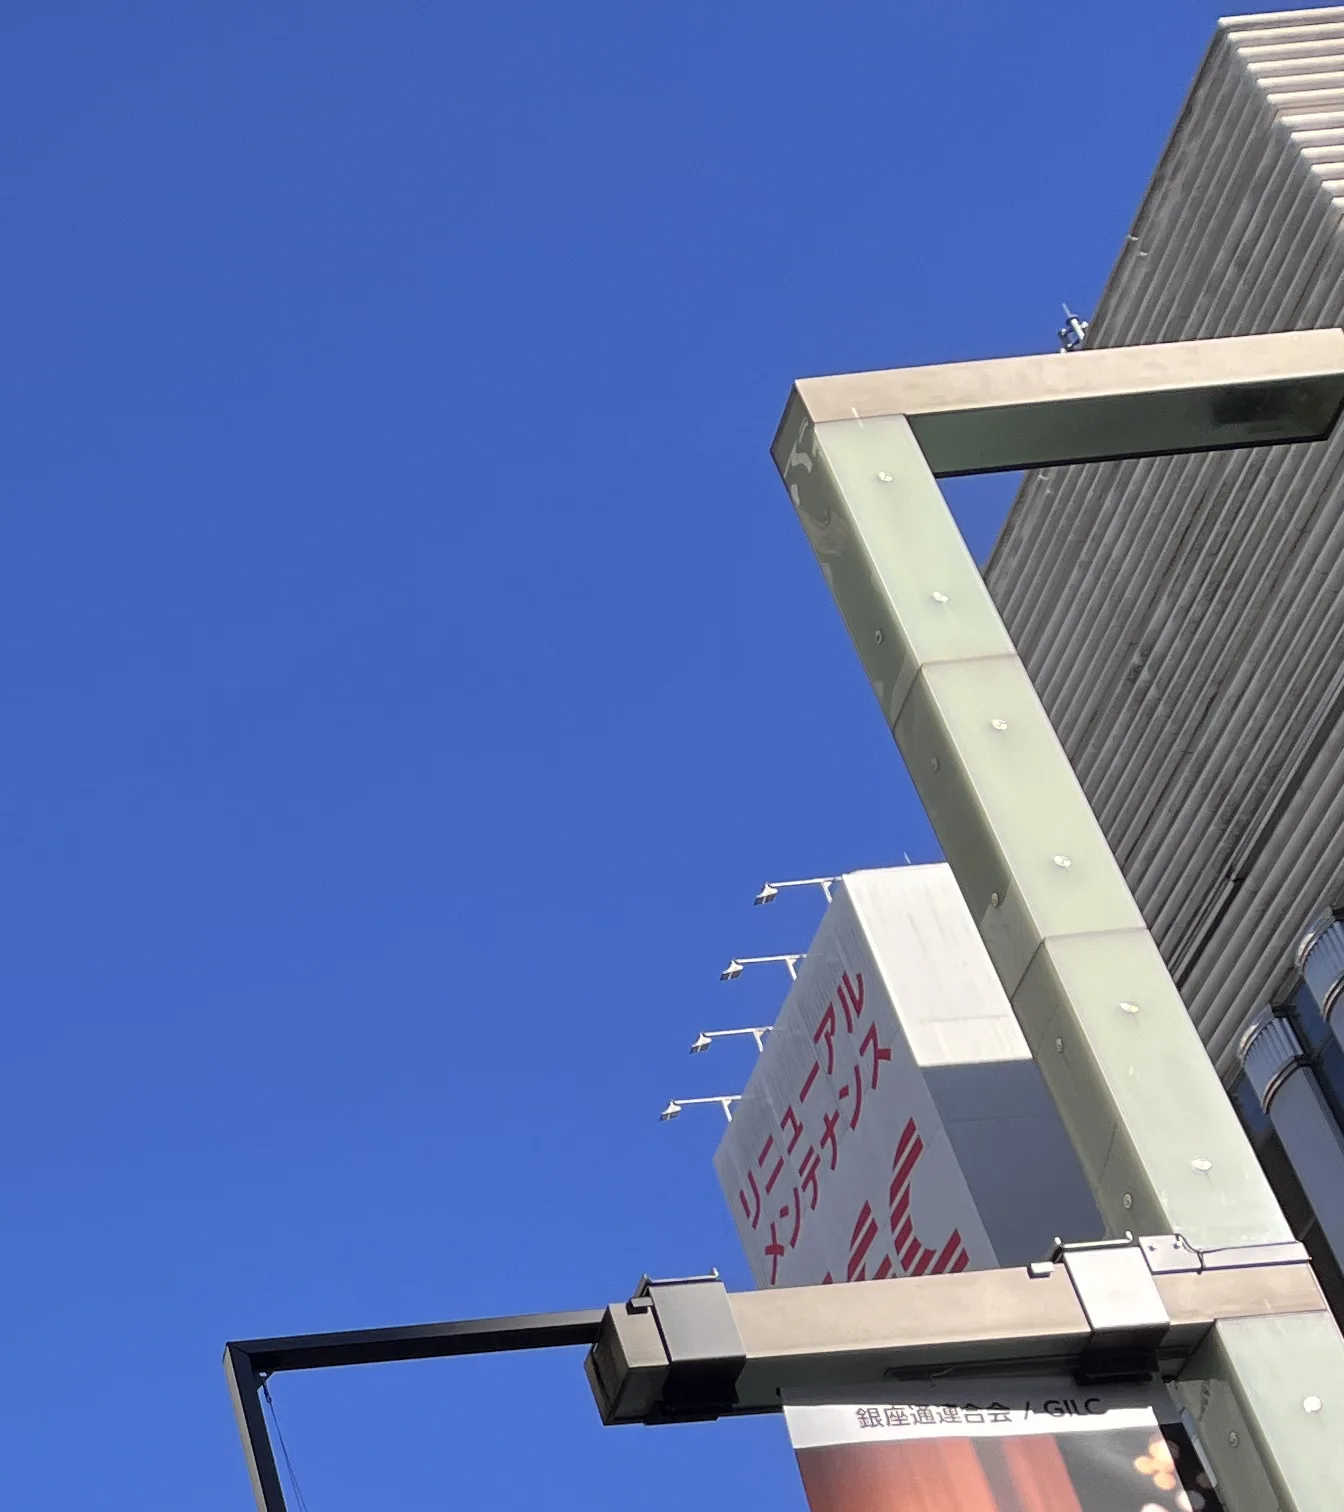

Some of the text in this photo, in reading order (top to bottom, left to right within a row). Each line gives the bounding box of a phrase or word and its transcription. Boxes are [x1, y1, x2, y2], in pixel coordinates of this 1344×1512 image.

[738, 970, 865, 1229] リニューアル
[763, 1022, 892, 1285] メンテナンス
[857, 1401, 1013, 1430] 銀座通連合会
